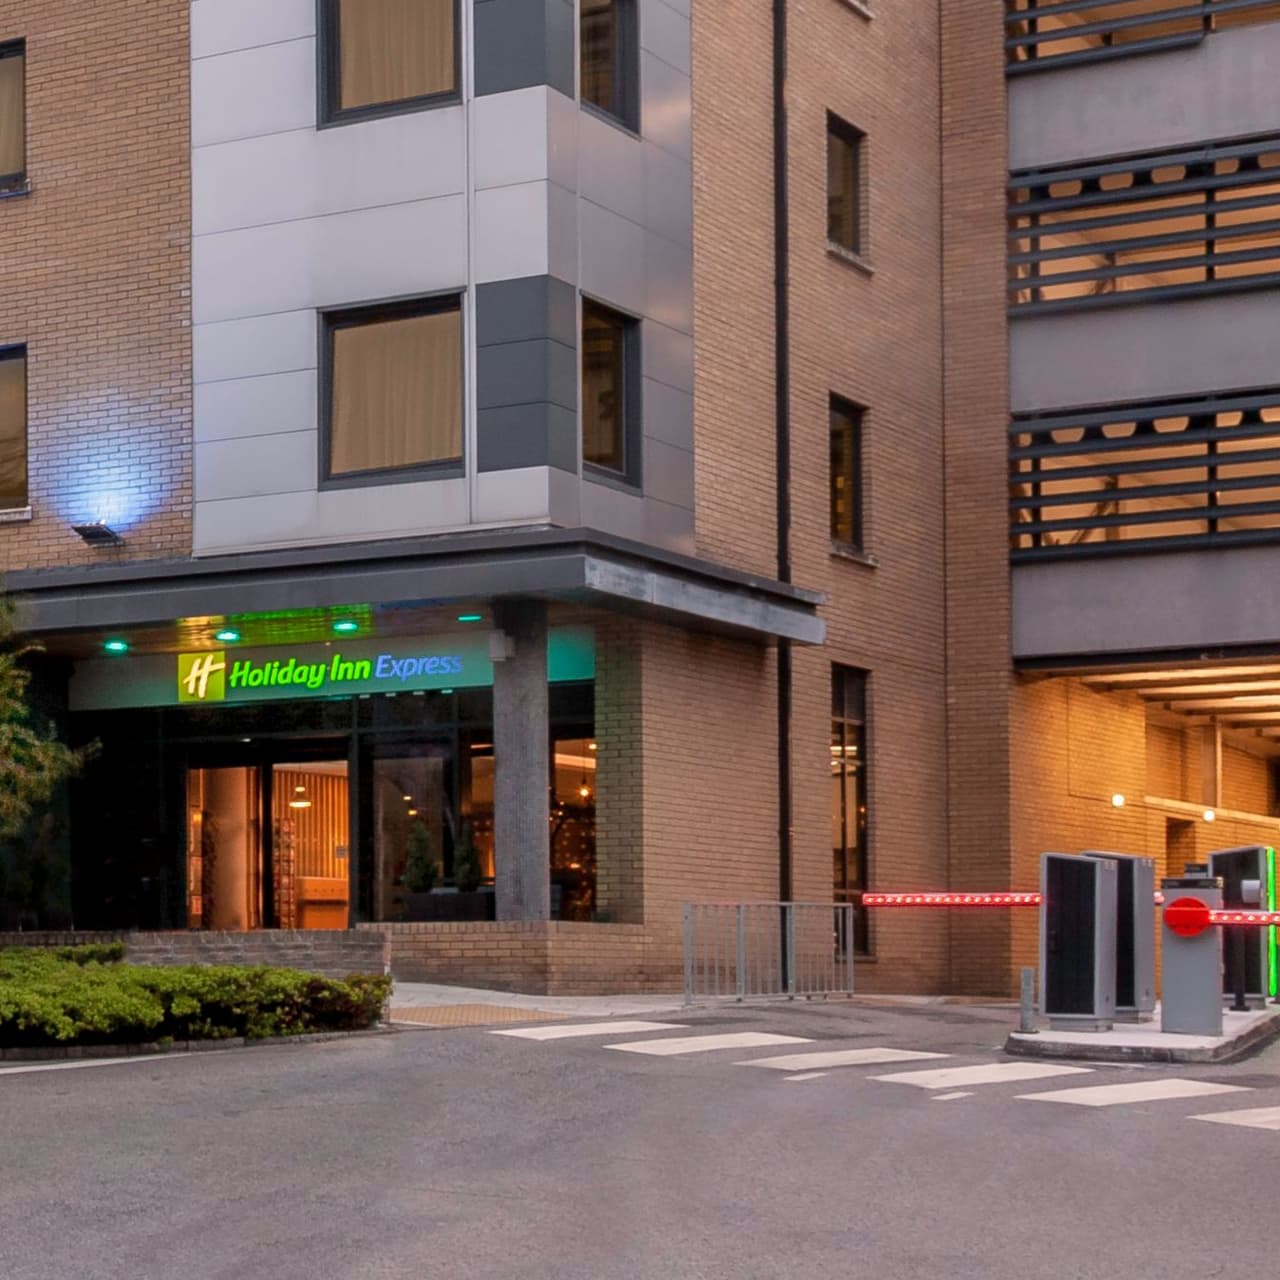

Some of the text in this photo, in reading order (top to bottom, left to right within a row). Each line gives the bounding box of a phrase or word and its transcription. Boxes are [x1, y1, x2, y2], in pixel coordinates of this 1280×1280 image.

[228, 657, 327, 689] Holiday
[329, 653, 373, 682] Inn
[374, 653, 465, 682] Express
